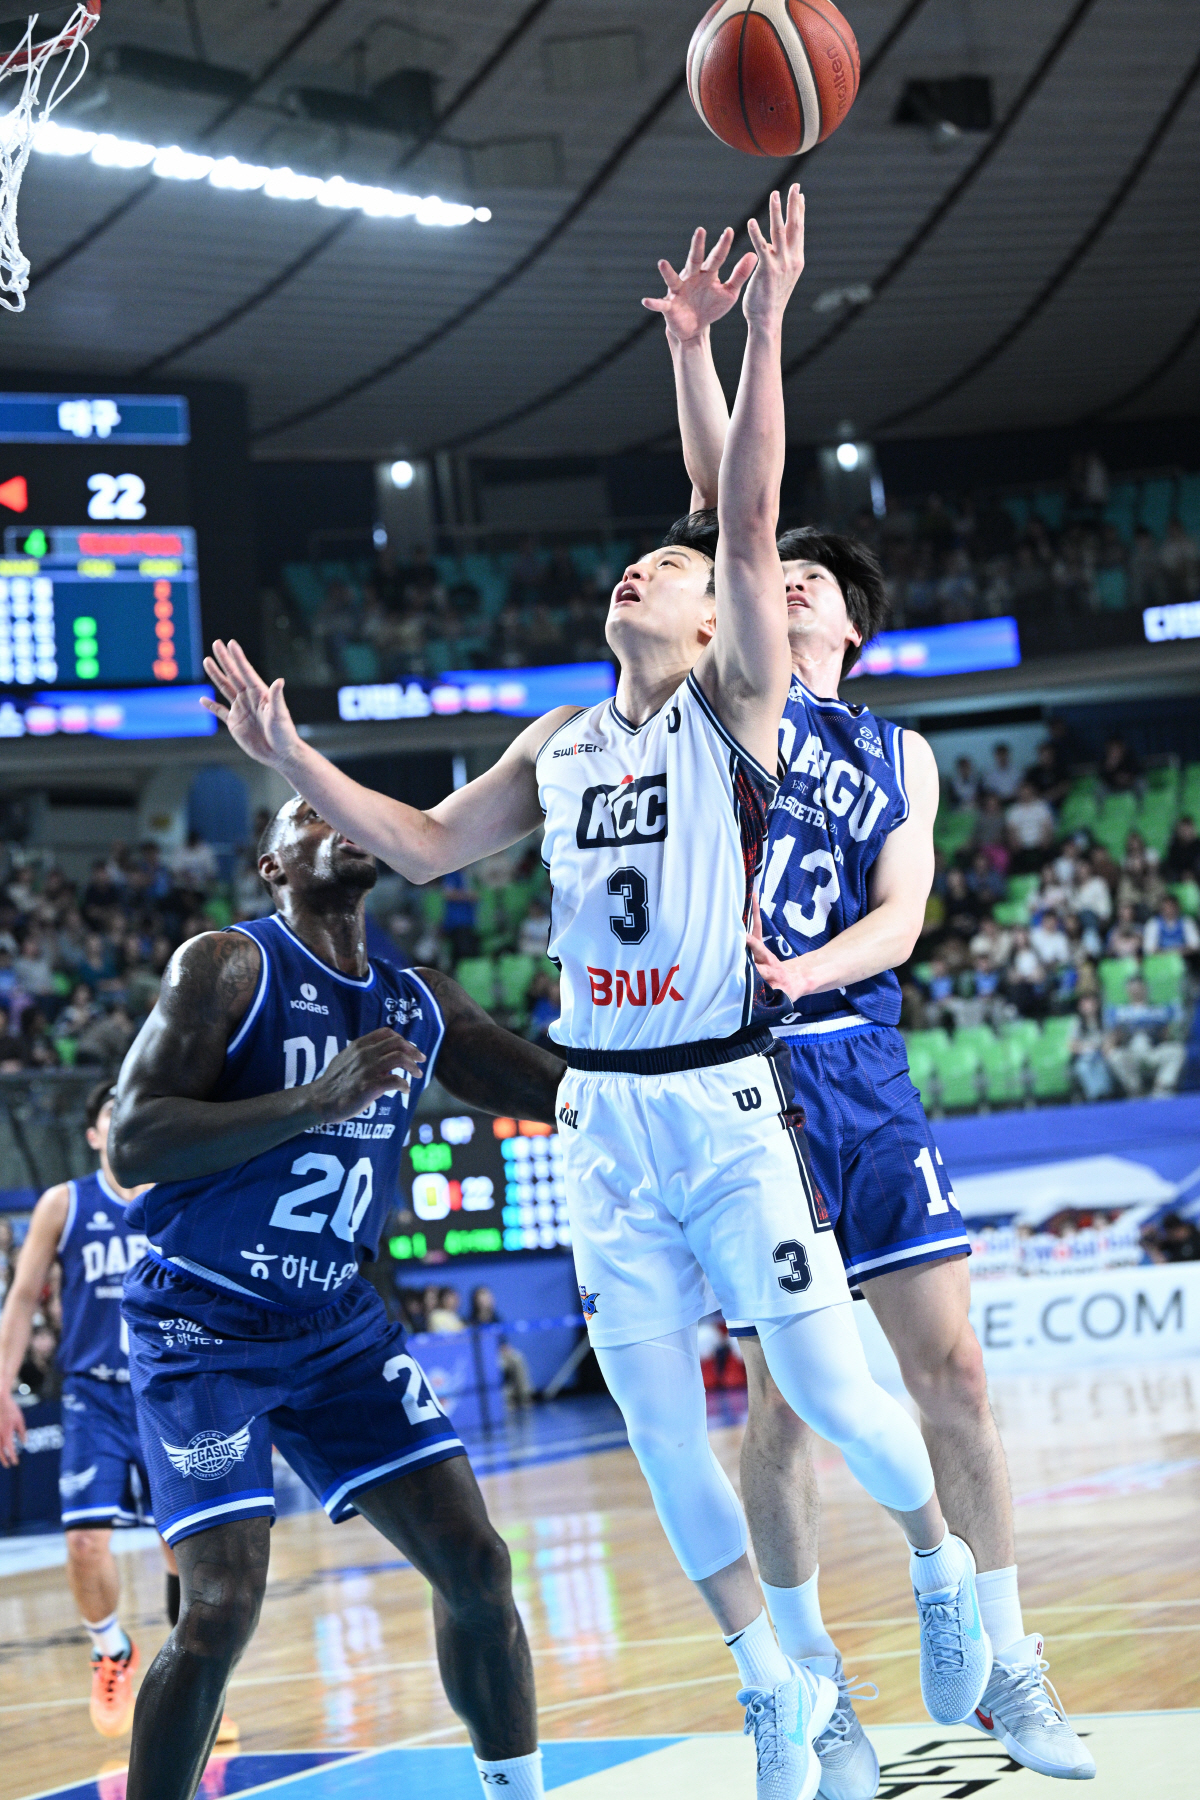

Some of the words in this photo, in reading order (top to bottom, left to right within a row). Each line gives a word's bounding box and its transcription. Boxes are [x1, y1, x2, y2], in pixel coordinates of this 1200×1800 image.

[87, 473, 147, 520] 22
[778, 718, 889, 842] DAGU
[584, 779, 668, 842] KCC
[607, 866, 649, 946] 3
[761, 834, 841, 938] 13
[586, 964, 685, 1008] BNK
[268, 1152, 373, 1243] 20
[82, 1233, 149, 1283] DAE
[772, 1239, 813, 1294] 3
[978, 1289, 1184, 1349] E.COM
[183, 1442, 239, 1472] PEGASUS
